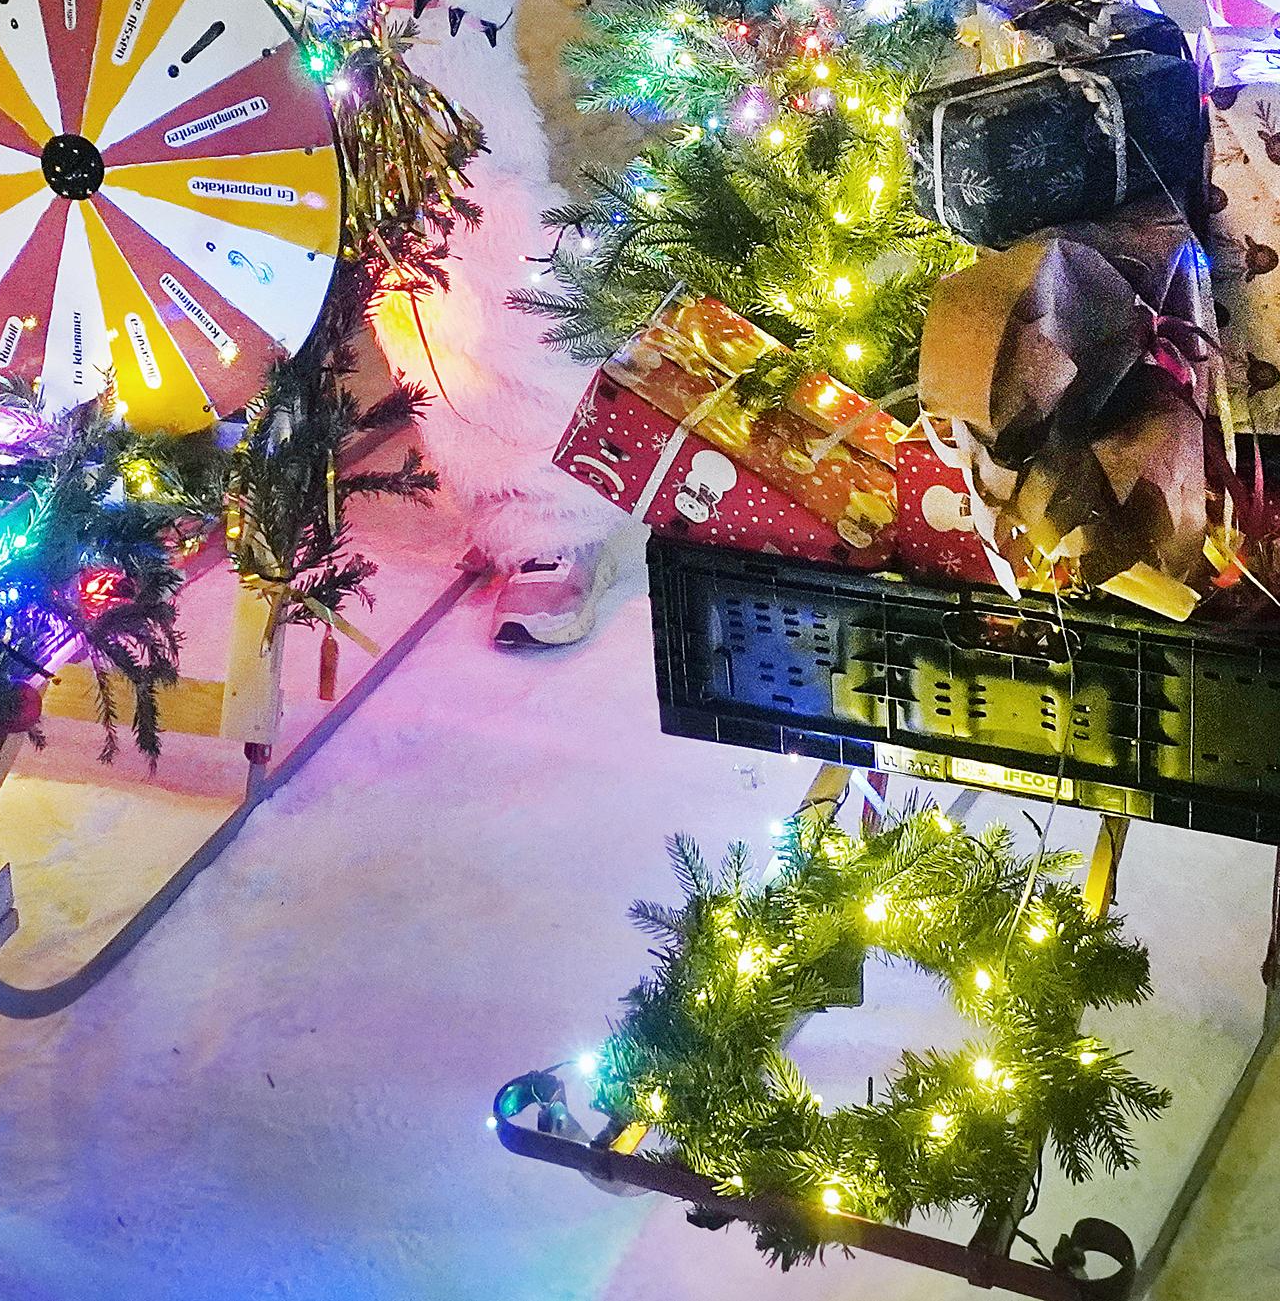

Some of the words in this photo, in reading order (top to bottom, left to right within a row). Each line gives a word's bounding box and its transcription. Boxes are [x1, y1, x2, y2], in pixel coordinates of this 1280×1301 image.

[168, 105, 248, 143] komplimenter
[192, 179, 272, 197] pepperkake
[162, 274, 220, 341] kompliment
[72, 311, 82, 366] klemmer
[1003, 769, 1046, 786] IFCO
